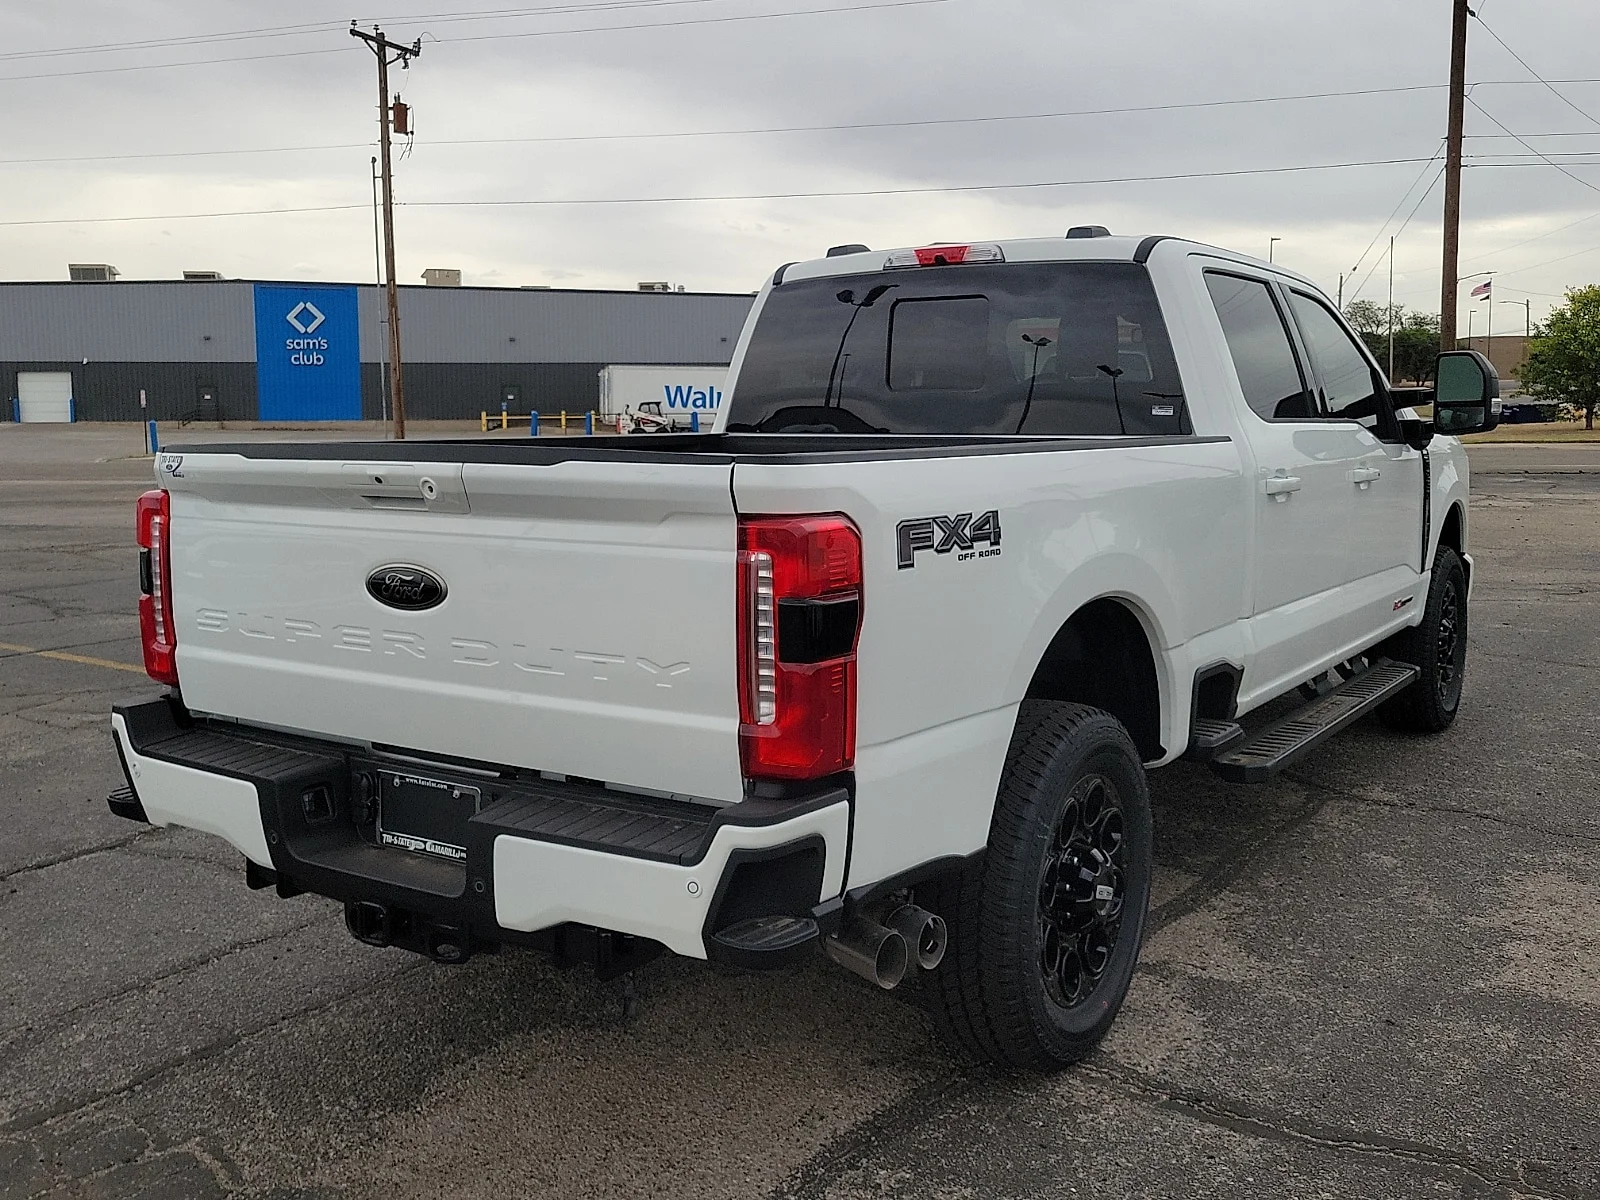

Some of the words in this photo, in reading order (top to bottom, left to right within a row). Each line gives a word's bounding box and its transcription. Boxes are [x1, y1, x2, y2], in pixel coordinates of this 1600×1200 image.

[286, 337, 328, 350] sam's
[291, 351, 324, 365] club
[896, 509, 1002, 570] FX4
[957, 552, 976, 562] OFF
[978, 548, 1001, 559] ROAD
[381, 572, 425, 600] Ford
[196, 607, 426, 658] SUPER
[450, 637, 691, 689] DUTY
[382, 834, 410, 847] TRI-STATE
